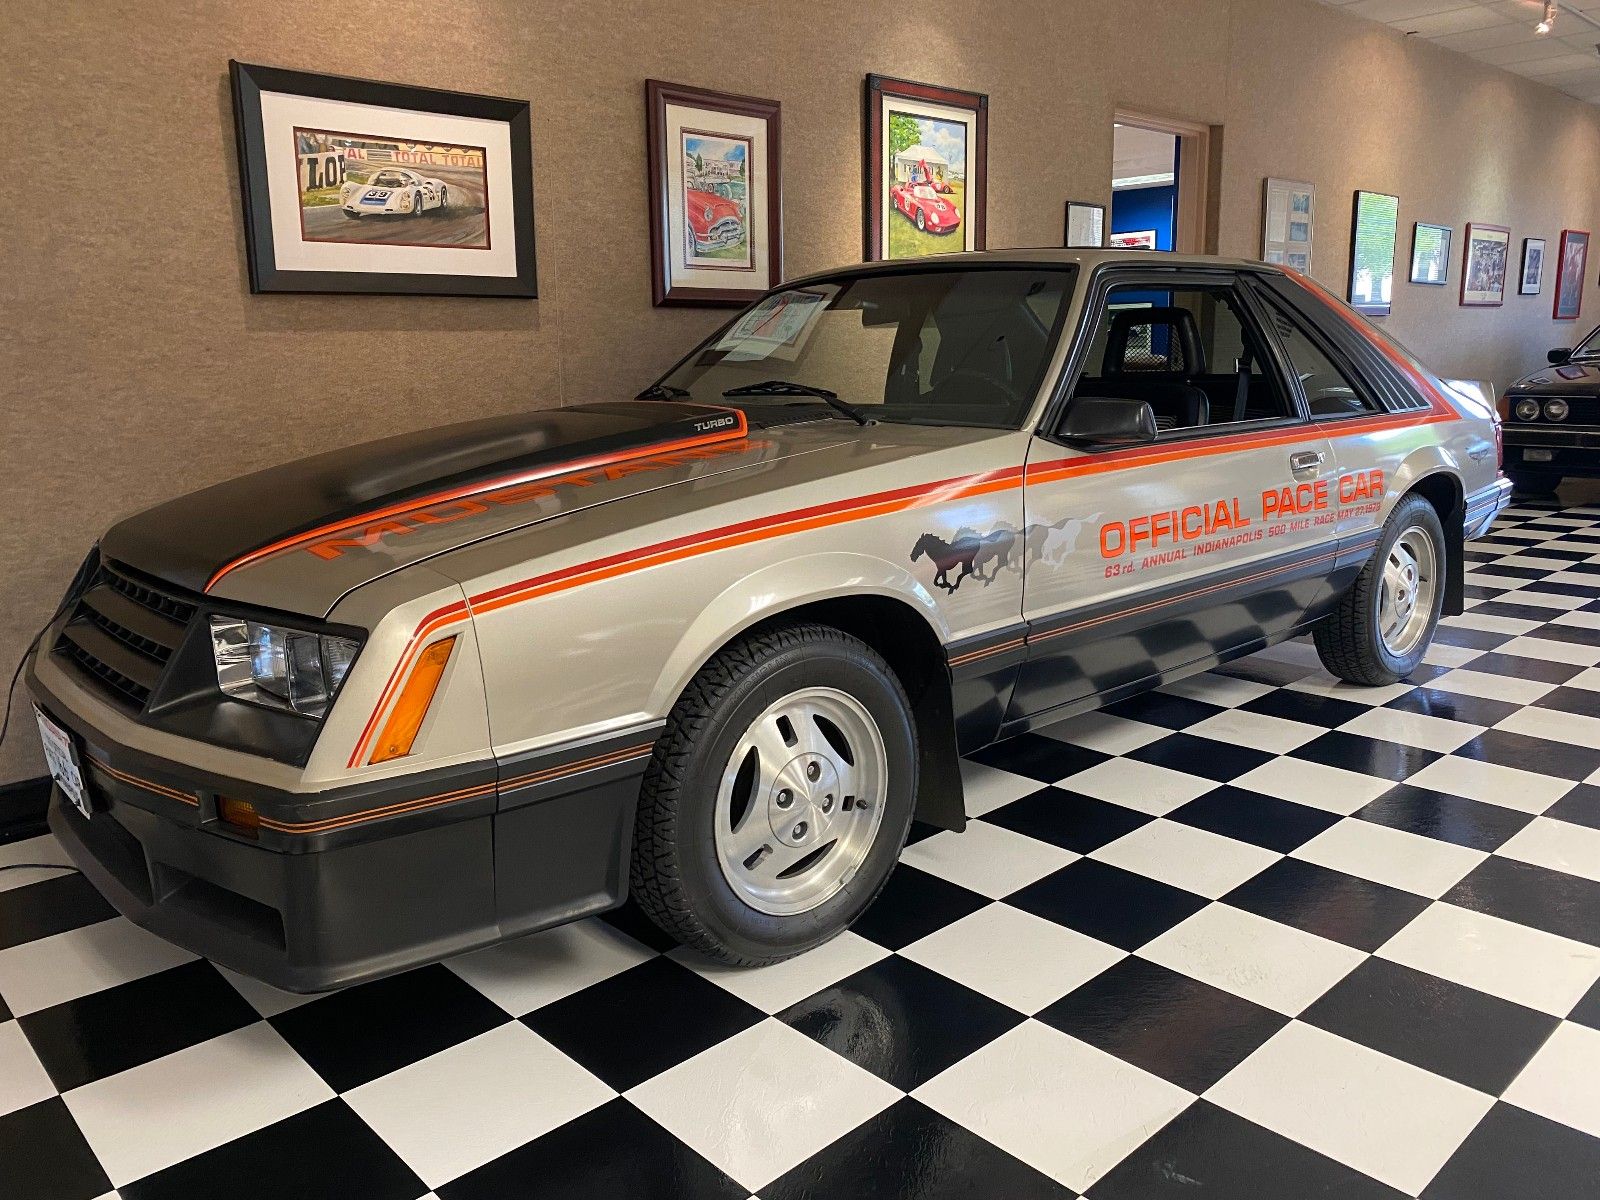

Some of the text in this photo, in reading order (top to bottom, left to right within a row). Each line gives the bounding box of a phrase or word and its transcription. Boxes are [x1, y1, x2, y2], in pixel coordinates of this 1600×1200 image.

[392, 151, 437, 166] TOTAL
[694, 416, 734, 432] TURBO
[1100, 469, 1385, 559] OFFICIAL PACE CAR
[1142, 548, 1187, 569] ANNUAL
[1193, 529, 1263, 556] INDIANAPOLIS
[1268, 524, 1286, 537] 500
[1290, 518, 1310, 532] MILE
[1313, 512, 1335, 526] RACE
[1337, 507, 1354, 521] MAY
